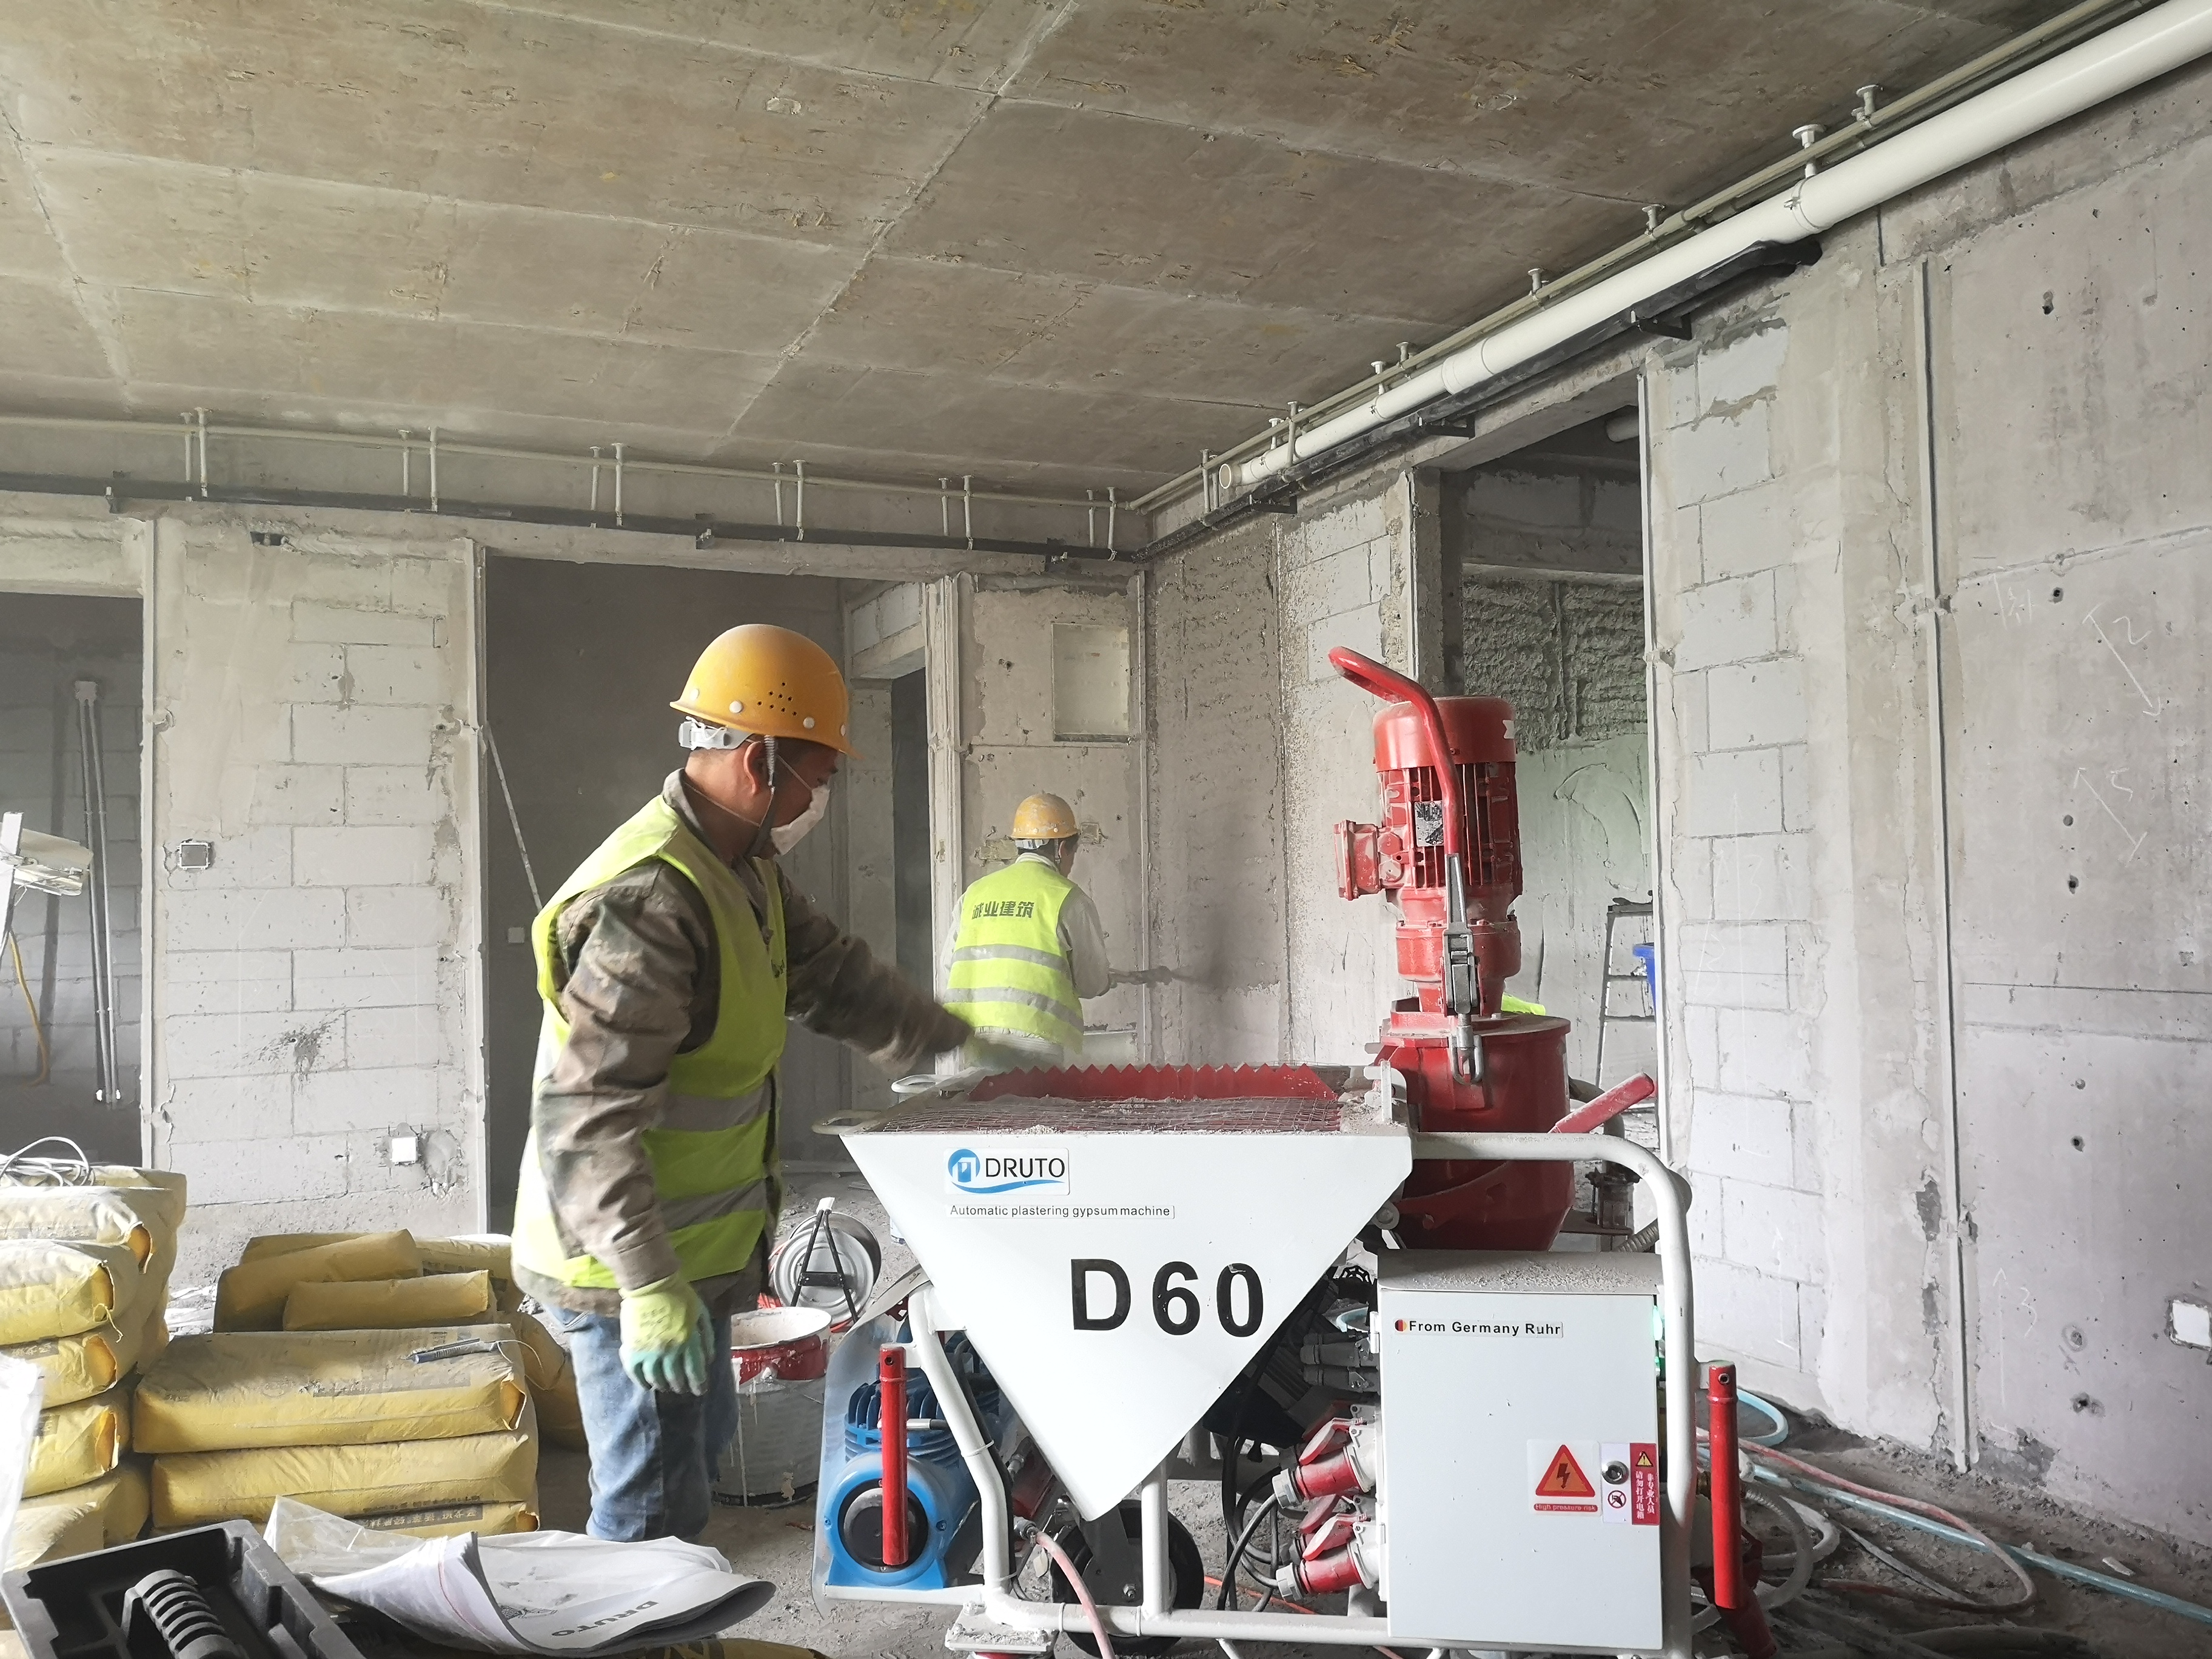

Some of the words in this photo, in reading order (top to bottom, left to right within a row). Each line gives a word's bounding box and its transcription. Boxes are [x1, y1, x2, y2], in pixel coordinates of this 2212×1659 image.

[986, 1158, 1065, 1178] DRUTO
[950, 1205, 1008, 1215] Automatic
[1012, 1205, 1069, 1218] plastering
[1073, 1208, 1118, 1218] gypsum
[1120, 1205, 1170, 1216] machine
[1409, 1321, 1446, 1332] From
[1452, 1321, 1520, 1336] Germany
[1525, 1323, 1561, 1335] Ruhr
